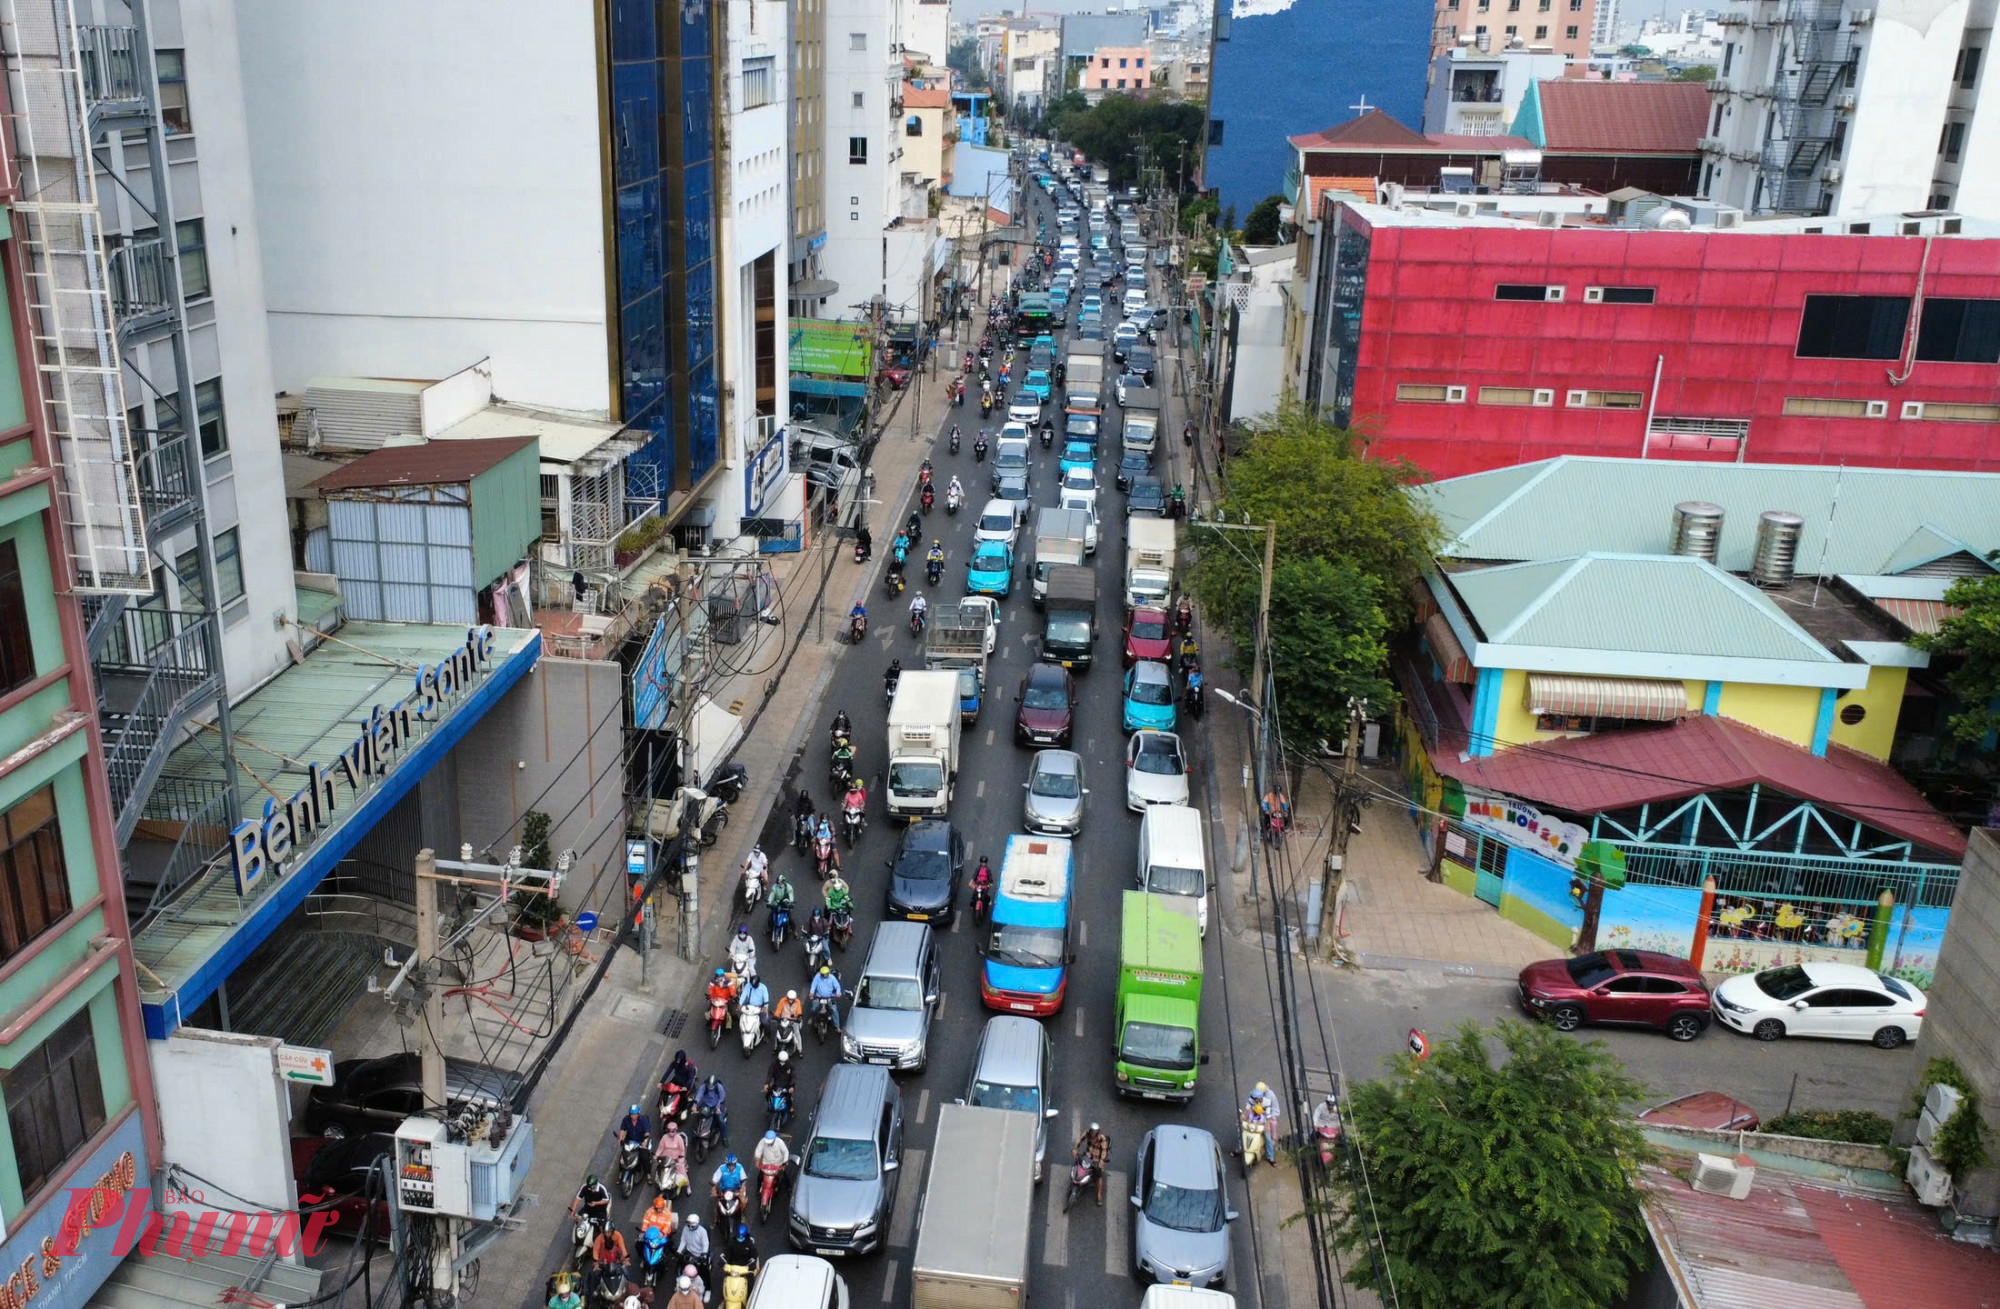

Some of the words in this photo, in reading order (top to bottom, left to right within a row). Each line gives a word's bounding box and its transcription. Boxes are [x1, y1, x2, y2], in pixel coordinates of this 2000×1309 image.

[230, 762, 339, 897] Bệnh
[340, 701, 412, 788] viện
[1507, 809, 1539, 833] NON
[65, 1152, 135, 1251] STUDIO
